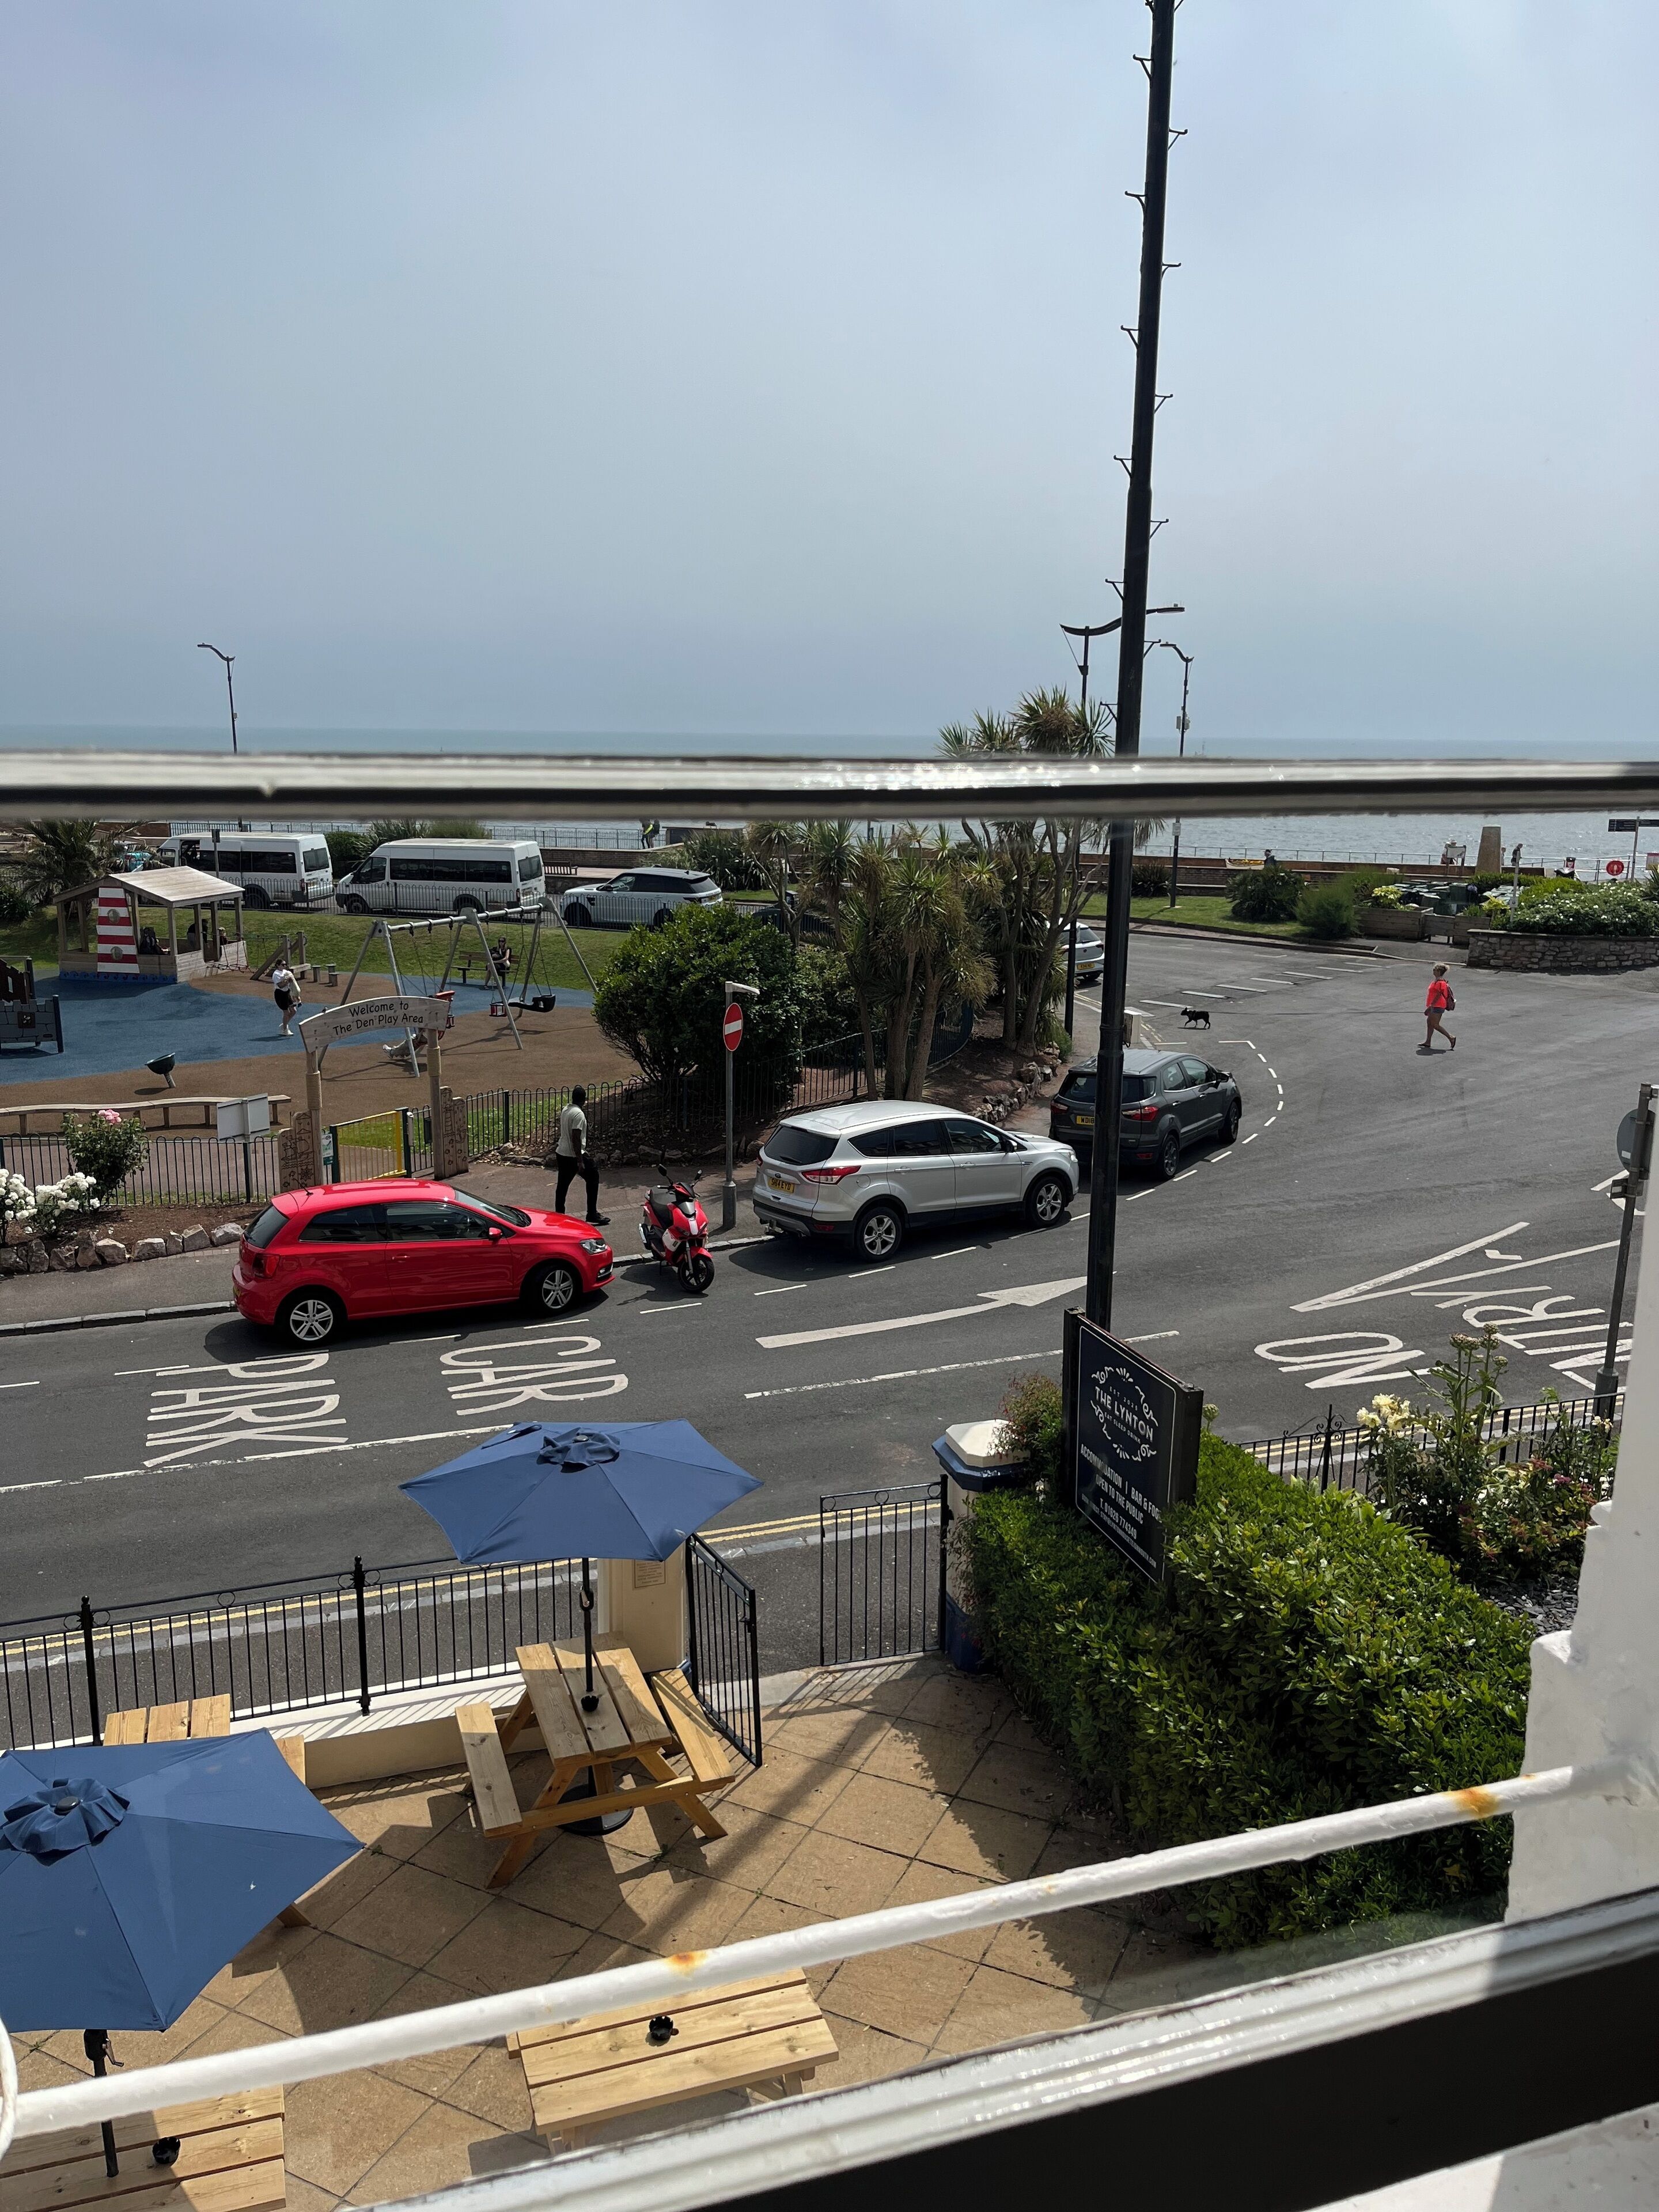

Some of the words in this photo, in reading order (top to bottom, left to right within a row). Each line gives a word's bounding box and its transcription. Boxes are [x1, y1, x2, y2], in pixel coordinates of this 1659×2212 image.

[333, 1022, 353, 1036] The
[356, 1017, 374, 1029] Den
[378, 1013, 398, 1026] Play
[401, 1012, 423, 1024] Area
[350, 1002, 394, 1017] Welcome
[400, 1001, 409, 1011] to
[1254, 1331, 1444, 1389] NO
[1410, 1285, 1634, 1392] NTRY
[440, 1335, 629, 1416] CAR
[143, 1353, 349, 1468] PARK
[1095, 1386, 1112, 1410] THE
[1115, 1401, 1153, 1442] LYNTON
[1081, 1444, 1122, 1488] ACCOMMODATION
[1131, 1487, 1142, 1506] BAR
[1143, 1498, 1147, 1510] &
[1148, 1502, 1161, 1523] FOO
[1096, 1474, 1108, 1493] OPEN
[1109, 1484, 1115, 1499] TO
[1116, 1491, 1125, 1509] THE
[1126, 1500, 1143, 1524] PUBLIC
[1119, 1516, 1137, 1539] 774349
